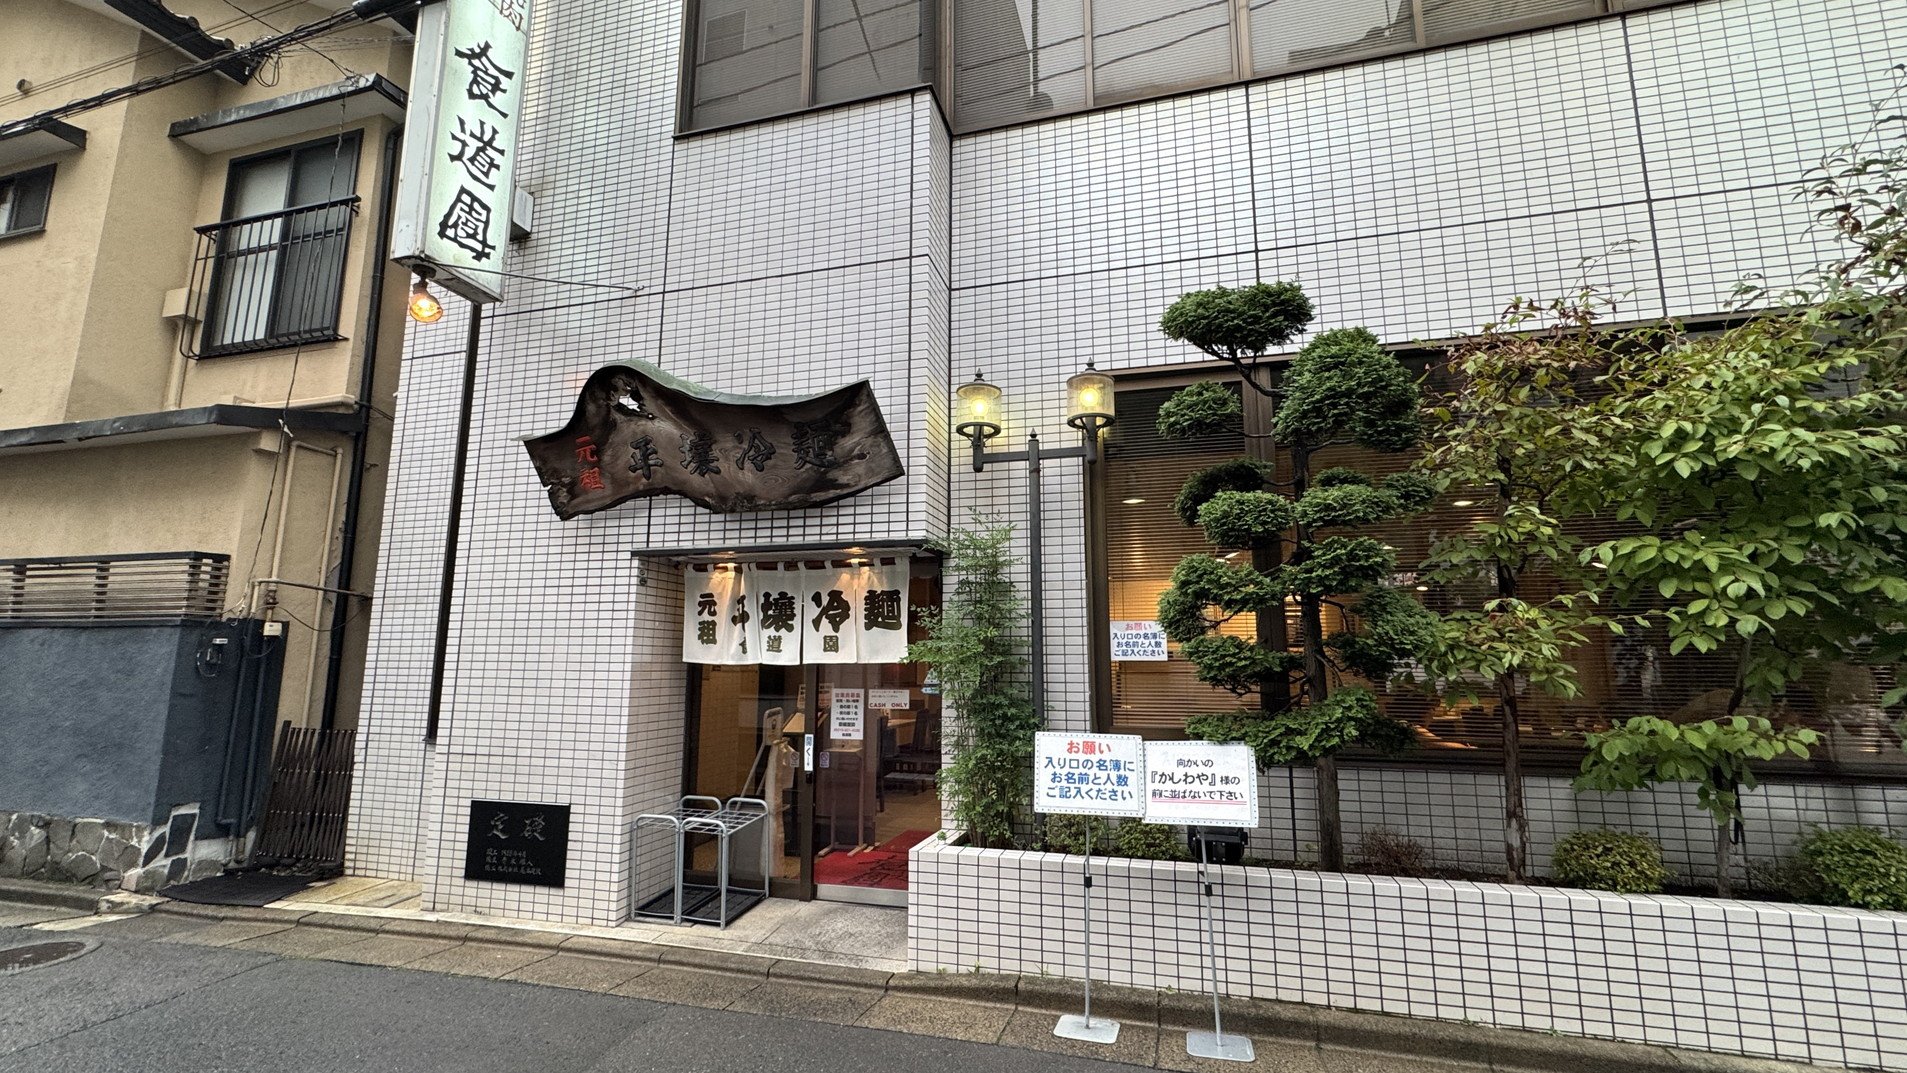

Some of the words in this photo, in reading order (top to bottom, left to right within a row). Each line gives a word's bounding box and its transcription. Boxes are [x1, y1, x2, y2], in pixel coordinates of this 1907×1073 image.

[437, 40, 515, 262] 食道園
[575, 435, 605, 489] 元祖
[697, 593, 717, 645] 元祖
[1125, 622, 1152, 631] お願い
[1066, 740, 1112, 755] お願い
[1044, 756, 1135, 772] 入り口の名簿に
[1177, 758, 1214, 768] 向かいの
[1051, 771, 1129, 787] お名前と人数
[1046, 786, 1133, 801] ご記入ください
[1152, 789, 1243, 801] 前に並ばないで下さい
